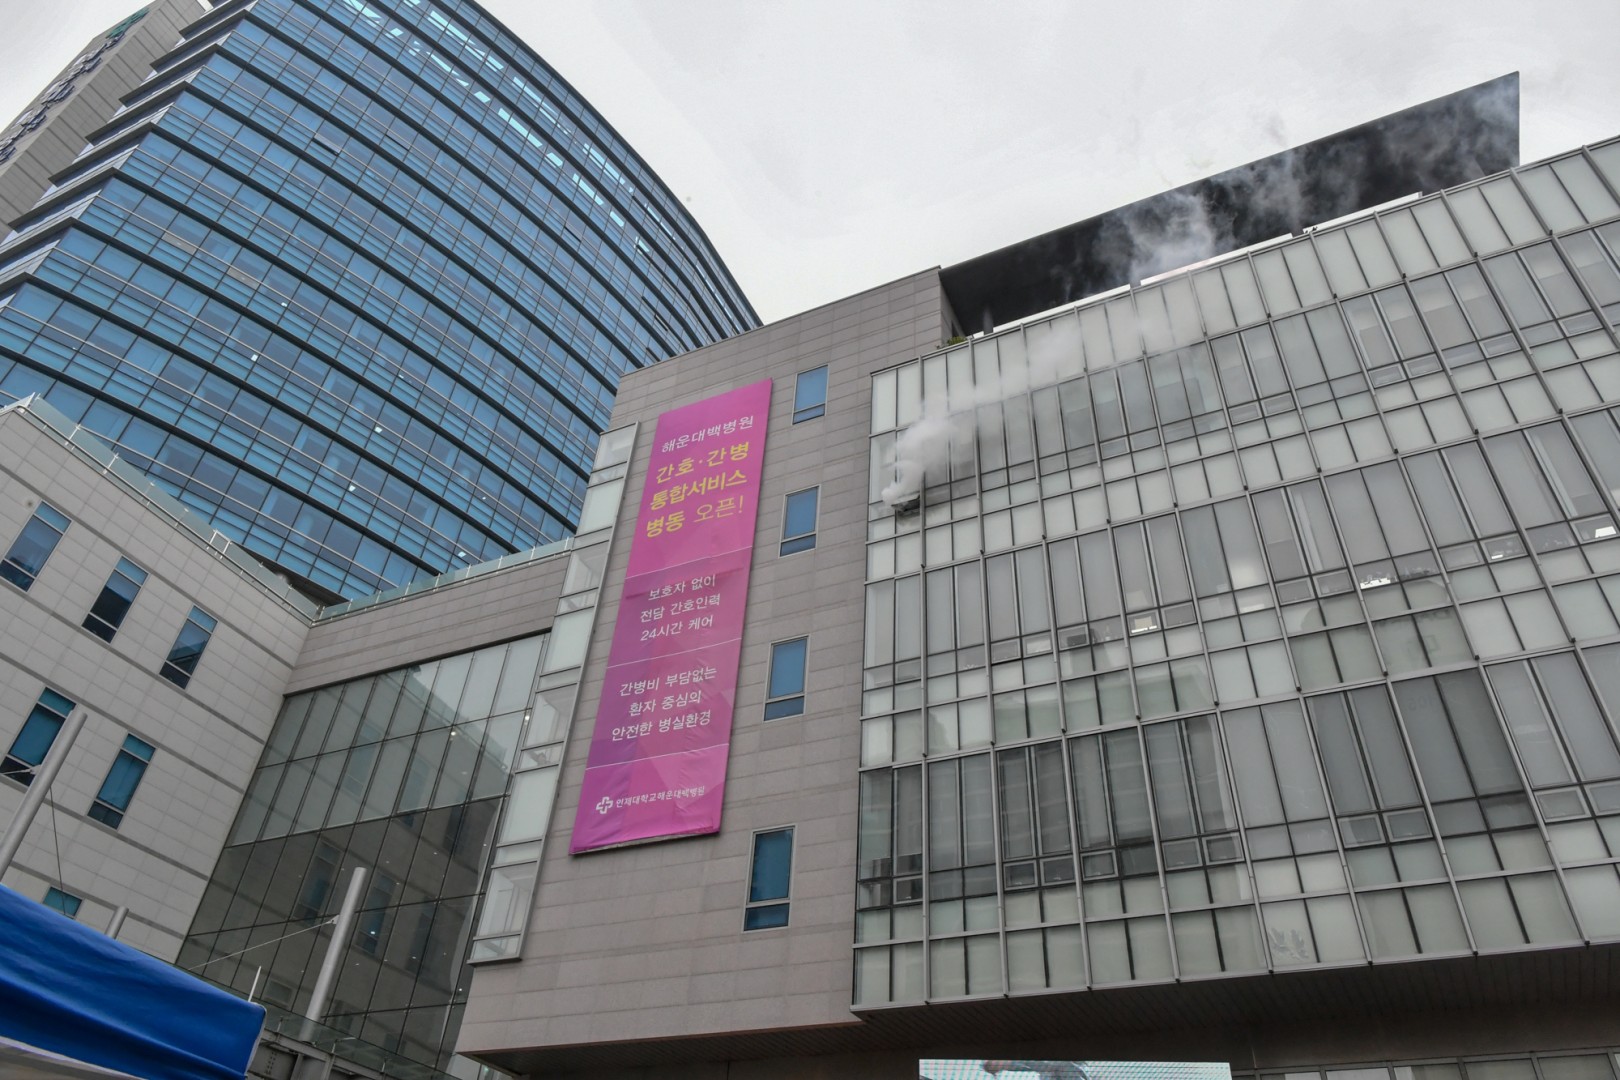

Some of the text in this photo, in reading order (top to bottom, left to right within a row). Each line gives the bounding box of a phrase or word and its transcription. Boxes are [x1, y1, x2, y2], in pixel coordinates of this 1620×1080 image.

[662, 416, 754, 452] 해운대백병원
[650, 470, 747, 511] 통합서비스
[646, 496, 744, 537] 병동 오픈!
[649, 575, 716, 601] 보호자 없이
[640, 594, 720, 623] 전담 간호인력
[640, 616, 714, 642] 24시간 케어
[619, 667, 718, 697] 간병비 부담없는
[628, 691, 702, 716] 환자 중심의
[611, 710, 712, 742] 안전한 병실환경
